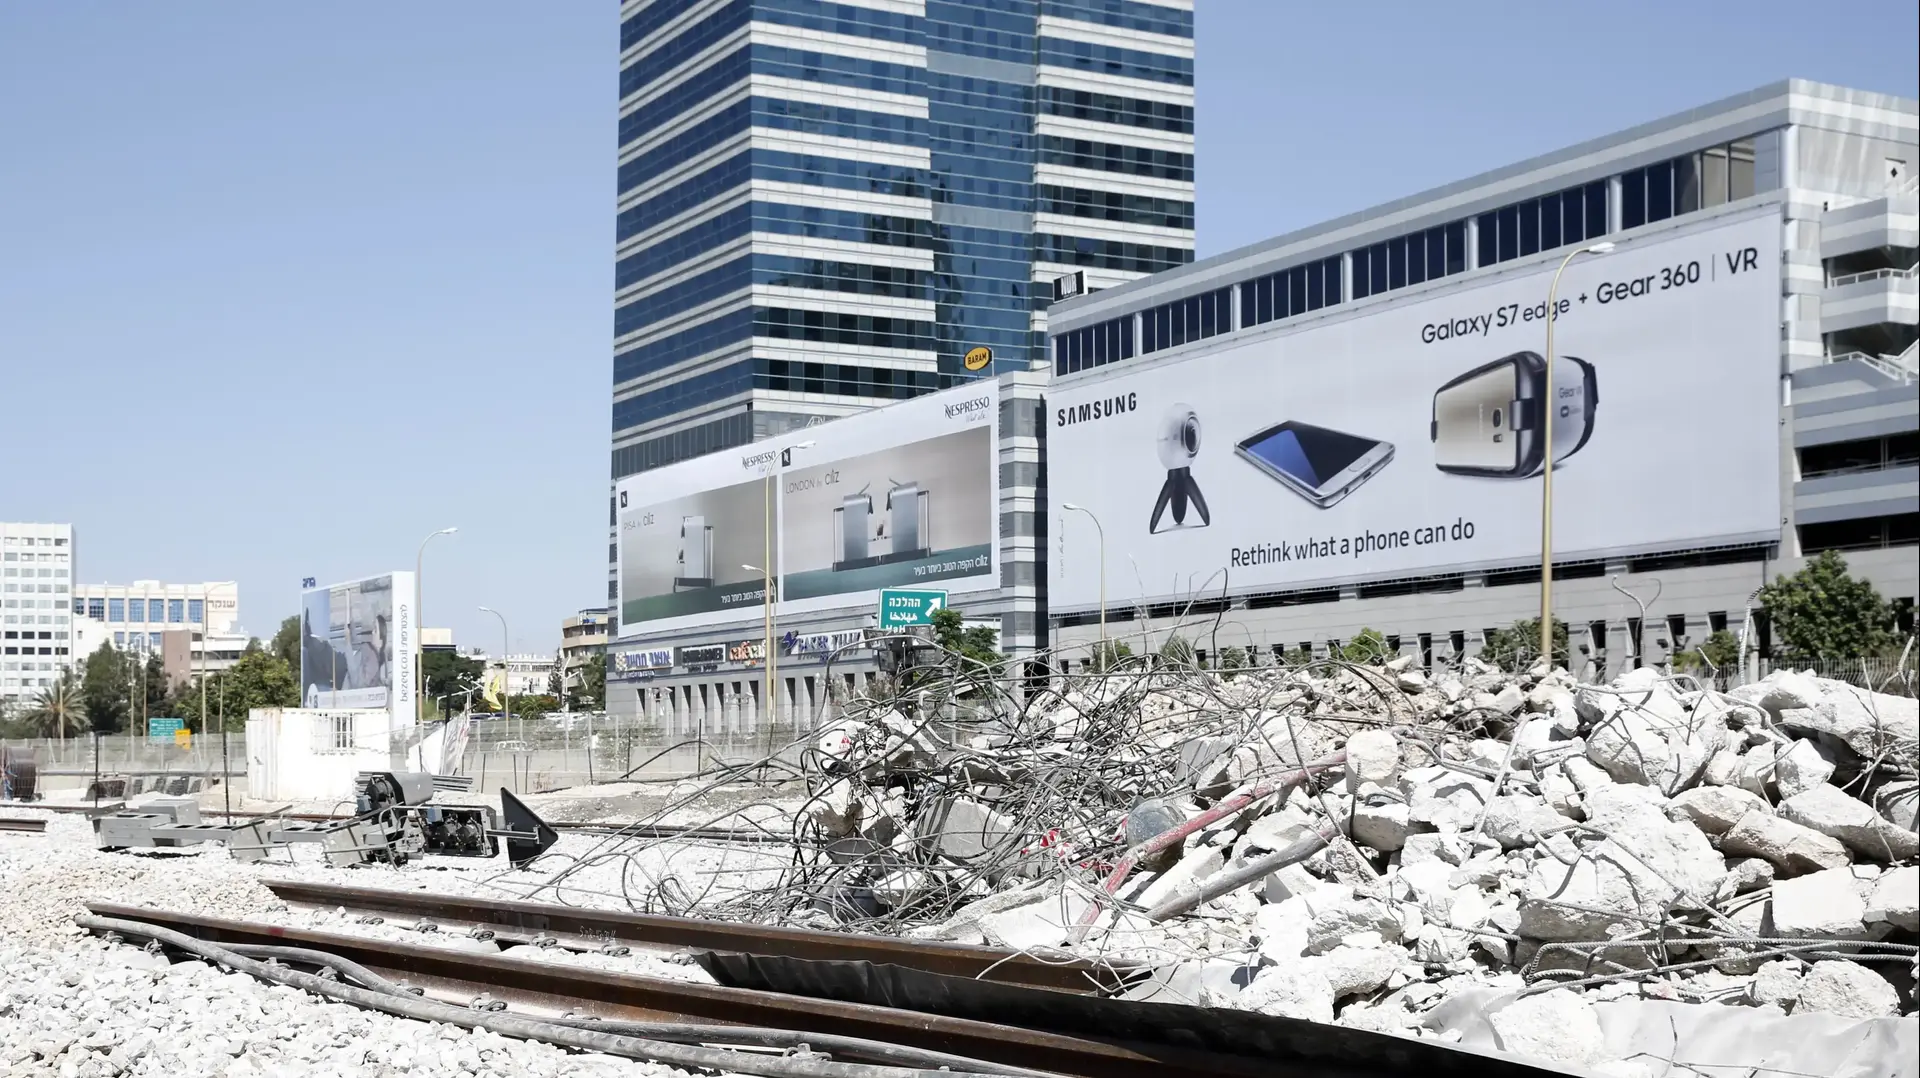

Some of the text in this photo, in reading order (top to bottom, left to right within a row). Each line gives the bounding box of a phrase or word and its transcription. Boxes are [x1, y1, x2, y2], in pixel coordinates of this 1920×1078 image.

[1061, 274, 1077, 296] NUR
[1422, 247, 1758, 344] Galaxy S7 edge + Gear 360 VR
[967, 352, 987, 366] BARAM
[1558, 387, 1575, 399] Gear
[944, 396, 990, 420] NESPRESSO
[1057, 392, 1137, 427] SAMSUNG
[741, 450, 776, 470] NESPRESSO
[786, 479, 815, 494] LONDON
[1231, 517, 1475, 568] Rethink what a phone can do
[913, 566, 926, 576] בעיר
[927, 563, 941, 574] ביותר
[943, 561, 957, 572] הטוב
[958, 559, 975, 572] הקפה
[207, 600, 235, 609] שנקר
[889, 596, 921, 607] ההלכה
[399, 649, 410, 702] bezeq.co.il
